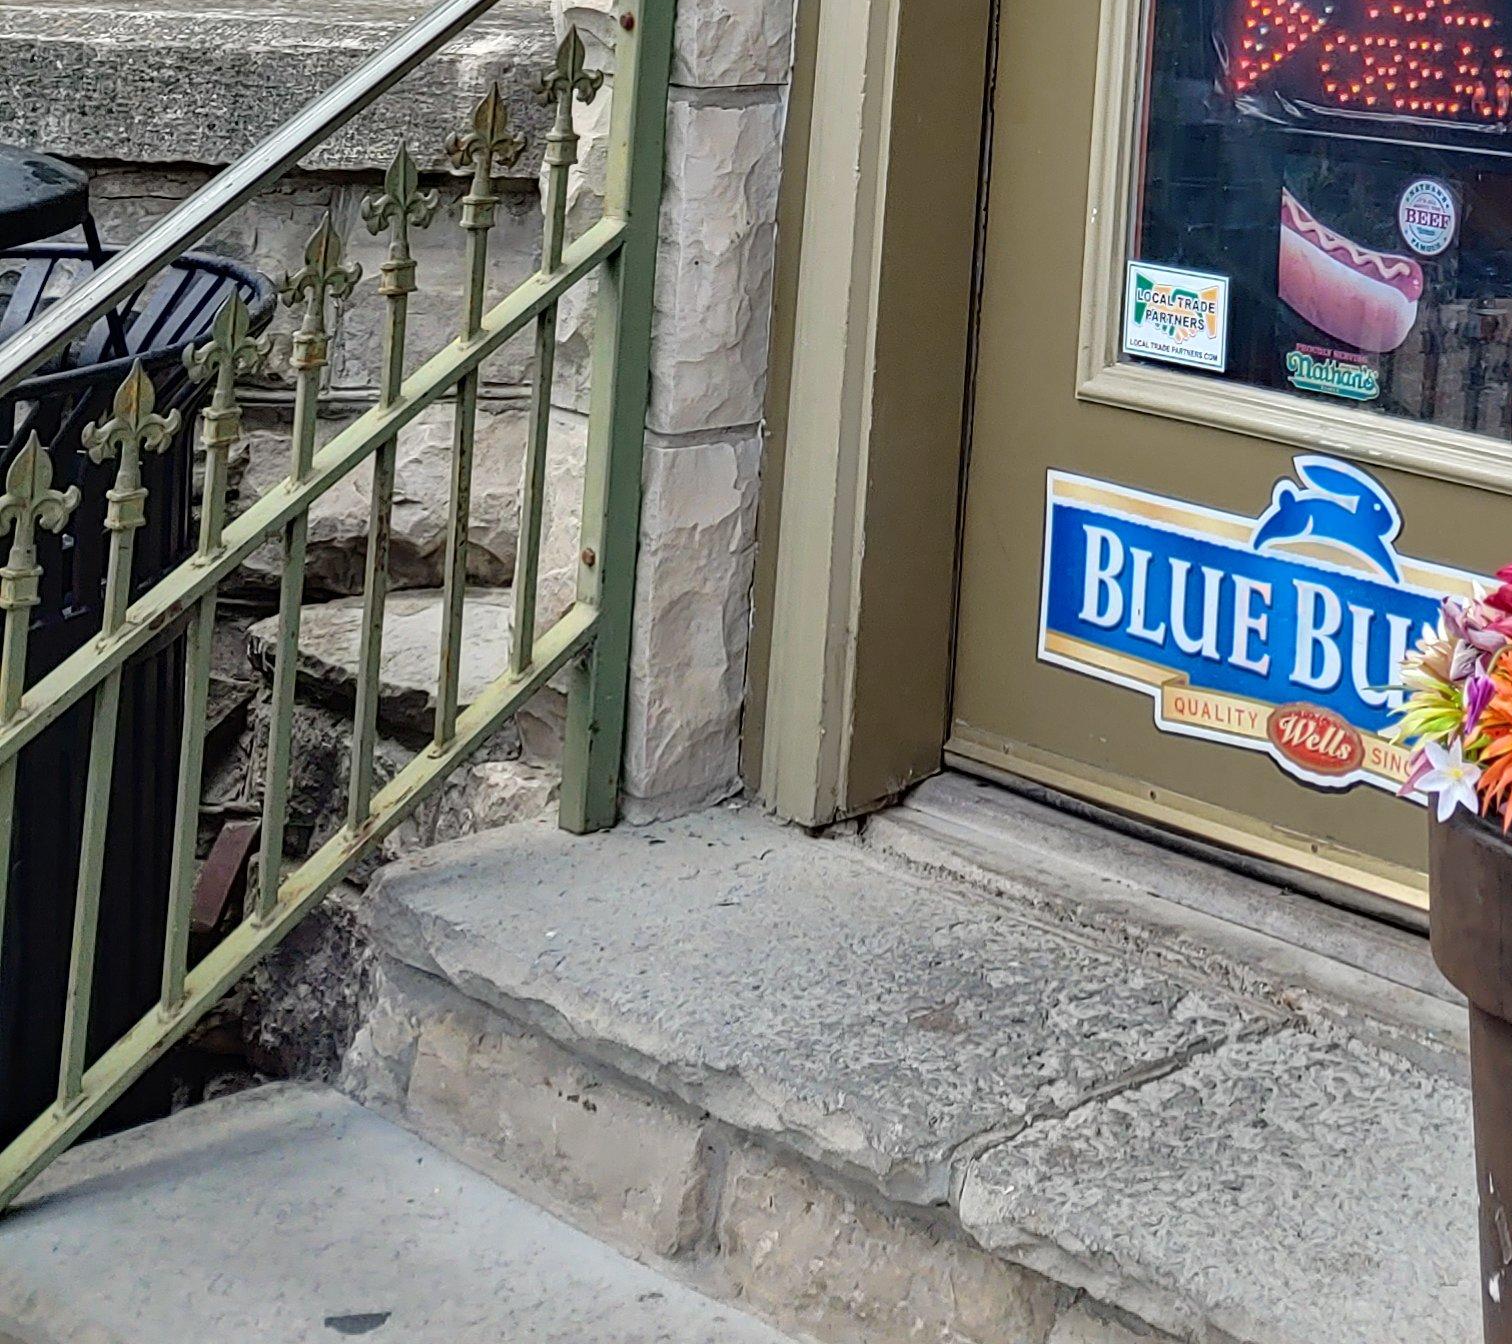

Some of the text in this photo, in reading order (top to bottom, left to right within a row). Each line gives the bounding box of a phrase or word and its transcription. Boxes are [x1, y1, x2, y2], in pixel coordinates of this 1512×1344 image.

[1404, 207, 1451, 230] BEEF
[1136, 289, 1216, 314] LOCAL TRADE
[1145, 309, 1206, 331] PARTNERS
[1129, 337, 1150, 349] LOCAL
[1150, 341, 1171, 353] TRADE
[1286, 351, 1378, 391] Nathan's
[1078, 523, 1412, 712] BLUE BU
[1173, 695, 1259, 730] QUALITY
[1279, 714, 1352, 761] Wells
